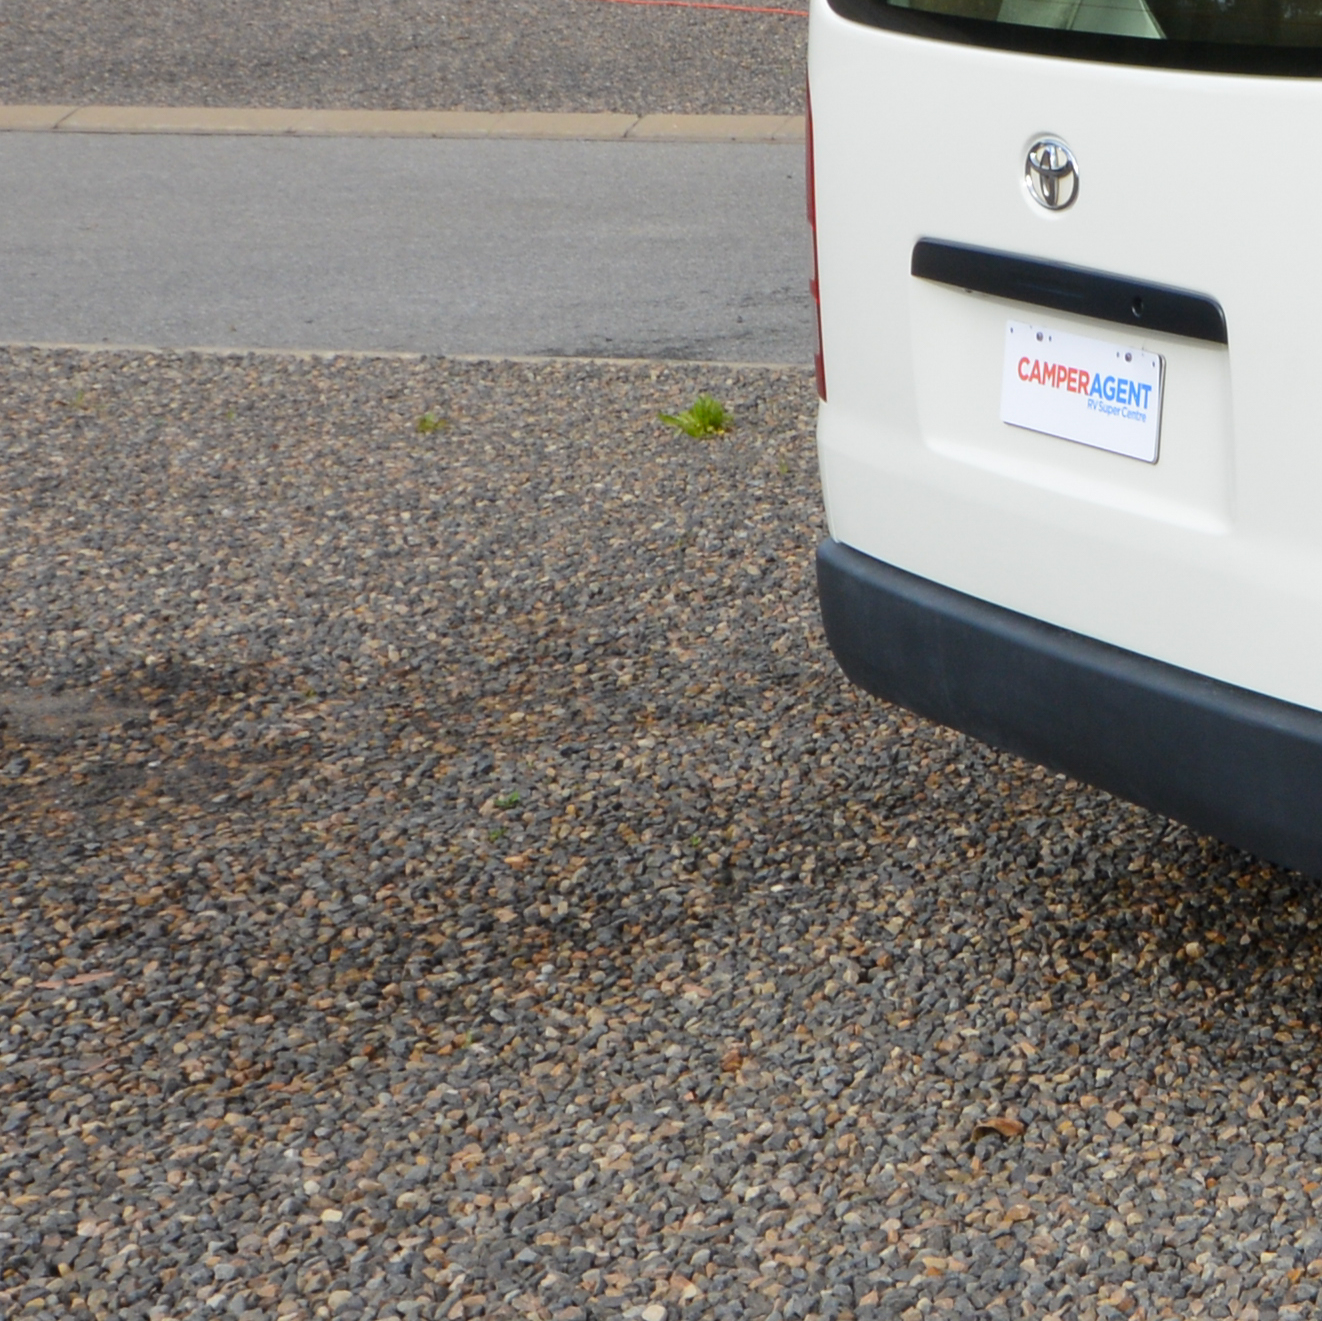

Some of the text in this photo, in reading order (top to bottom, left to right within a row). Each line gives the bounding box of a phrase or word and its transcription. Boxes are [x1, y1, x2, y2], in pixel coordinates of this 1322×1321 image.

[1017, 356, 1152, 410] CAMPERAGENT
[1087, 398, 1147, 423] RV Super Centre
